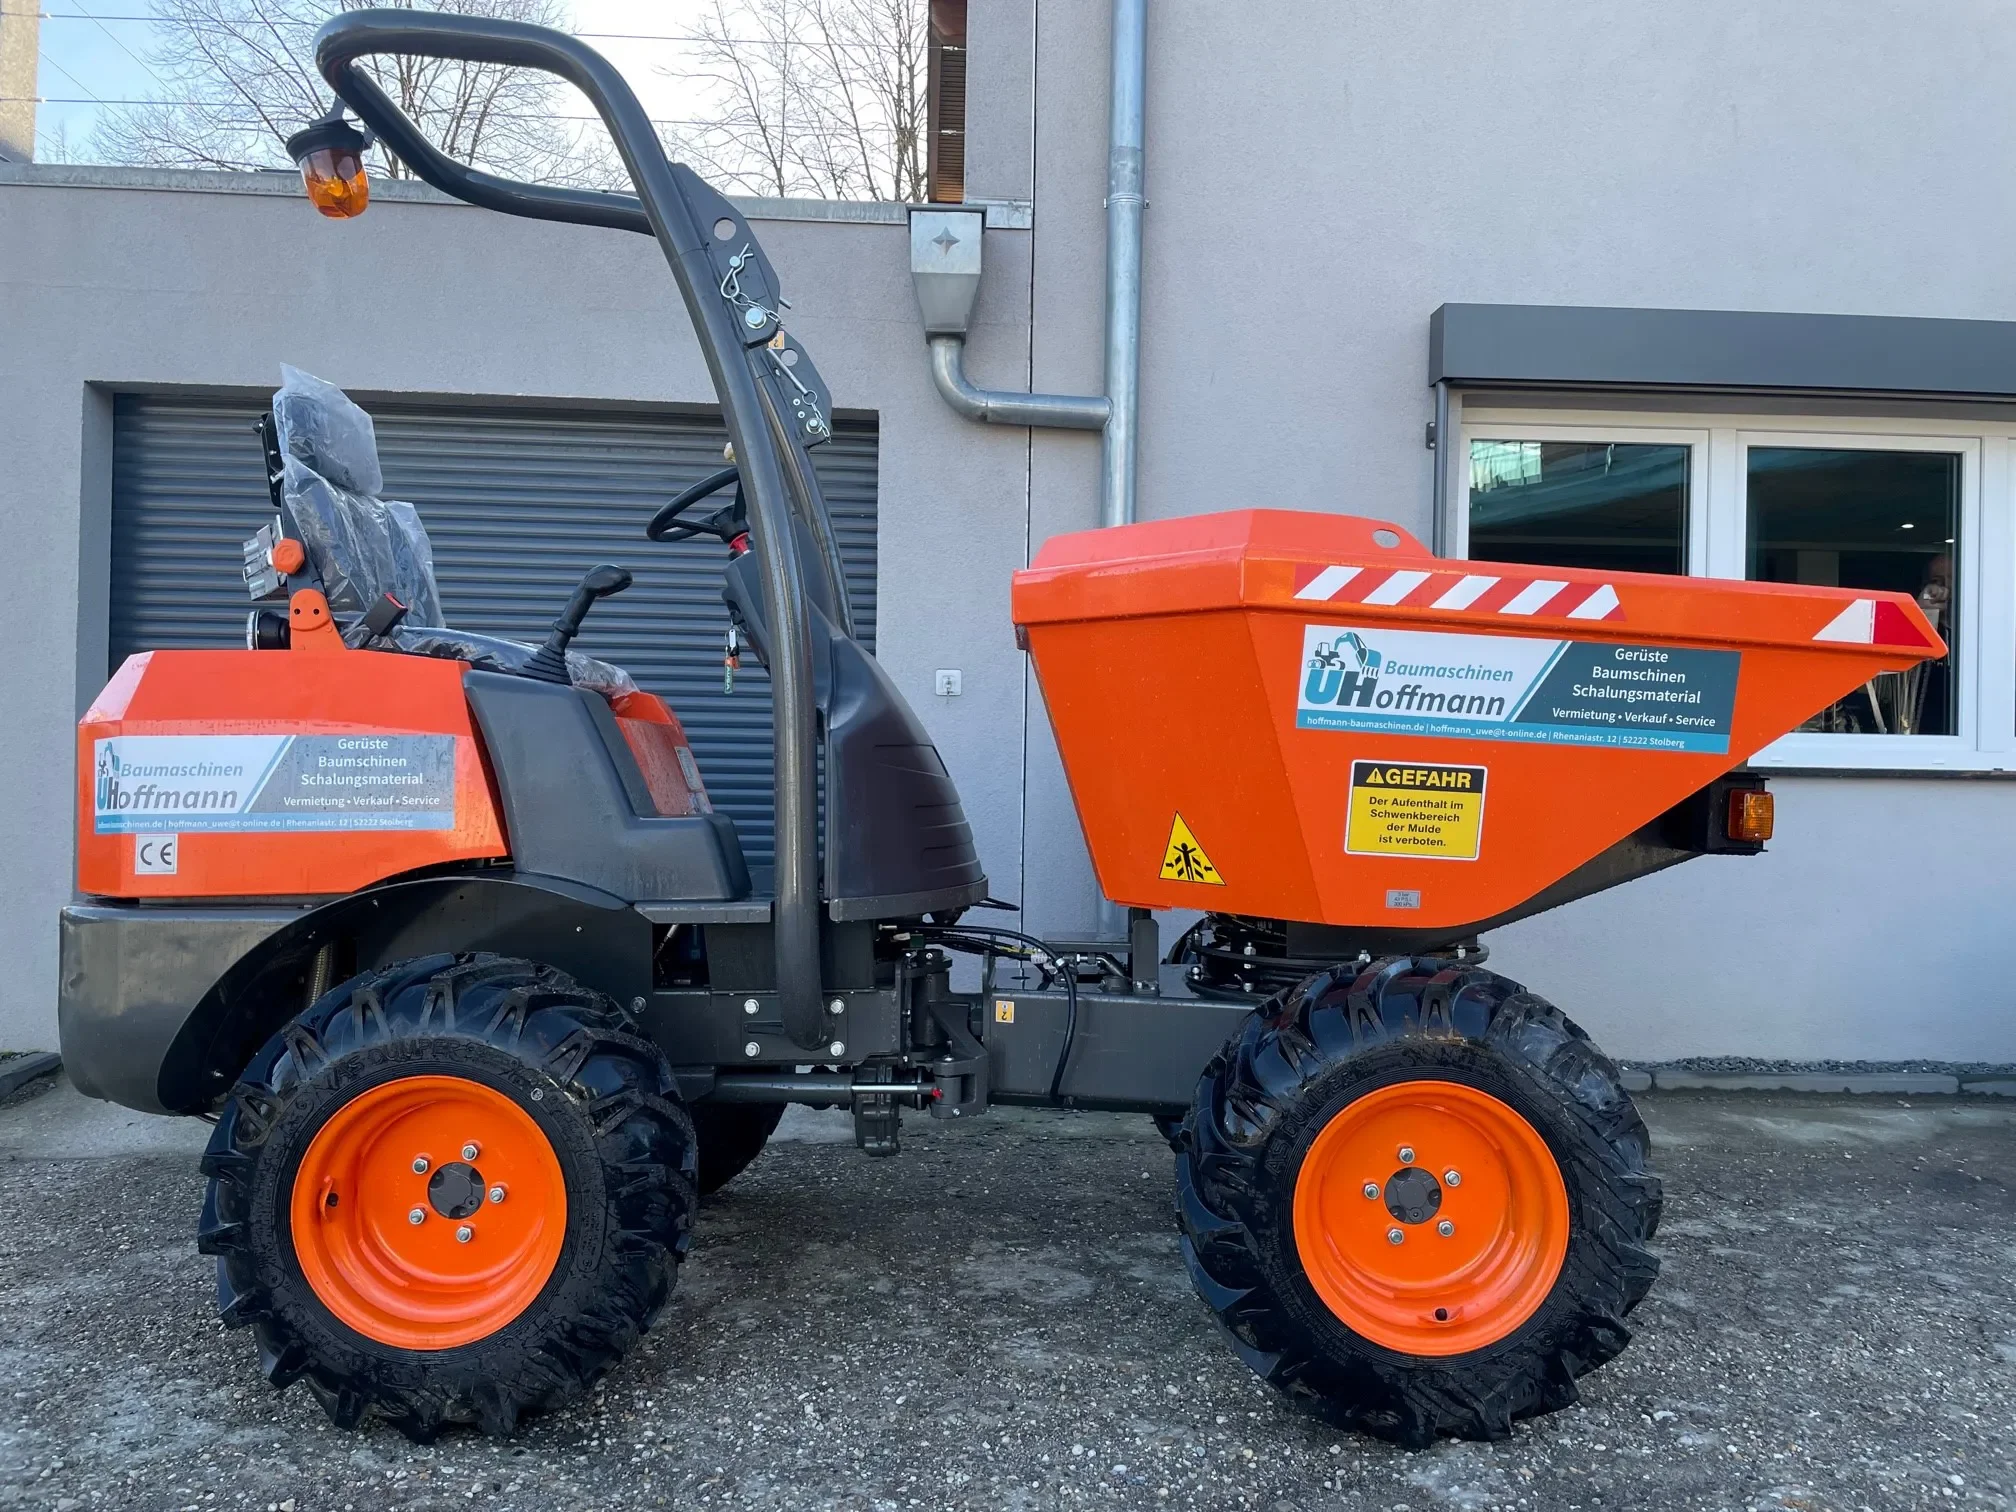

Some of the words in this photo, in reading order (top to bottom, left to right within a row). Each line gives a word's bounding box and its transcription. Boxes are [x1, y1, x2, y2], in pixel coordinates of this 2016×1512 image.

[1615, 647, 1669, 663] Gerüste
[1384, 660, 1514, 682] Baumaschinen
[1592, 665, 1687, 684] Baumschinen
[1572, 684, 1701, 704] Schalungsmaterial
[1552, 707, 1616, 724] Vermietung
[1624, 711, 1667, 725] Verkauf
[1675, 714, 1716, 727] Service
[1306, 716, 1425, 732] hoffmann-baumaschinen.de
[1430, 724, 1547, 739] hoffmann_uwe@t-online.de
[1553, 731, 1605, 743] Rhenaniastr.
[1607, 735, 1617, 743] 12
[1622, 736, 1648, 745] 52222
[1649, 737, 1685, 749] Stolberg
[337, 738, 389, 750] Gerüste
[318, 755, 407, 767] Baumschinen
[121, 762, 244, 778] Baumaschinen
[301, 773, 424, 788] Schalungsmaterial
[1385, 768, 1472, 789] GEFAHR
[284, 796, 345, 808] Vermietung
[353, 795, 395, 806] Verkauf
[402, 795, 441, 806] Service
[1369, 796, 1389, 806] Der
[1391, 797, 1447, 809] Aufenthalt
[1450, 800, 1464, 810] im
[339, 818, 348, 827] 12
[1370, 808, 1460, 822] Schwenkbereich
[1386, 822, 1405, 832] der
[1408, 823, 1441, 834] Mulde
[1379, 835, 1393, 844] ist
[1395, 835, 1446, 847] verboten.
[140, 842, 173, 866] CE
